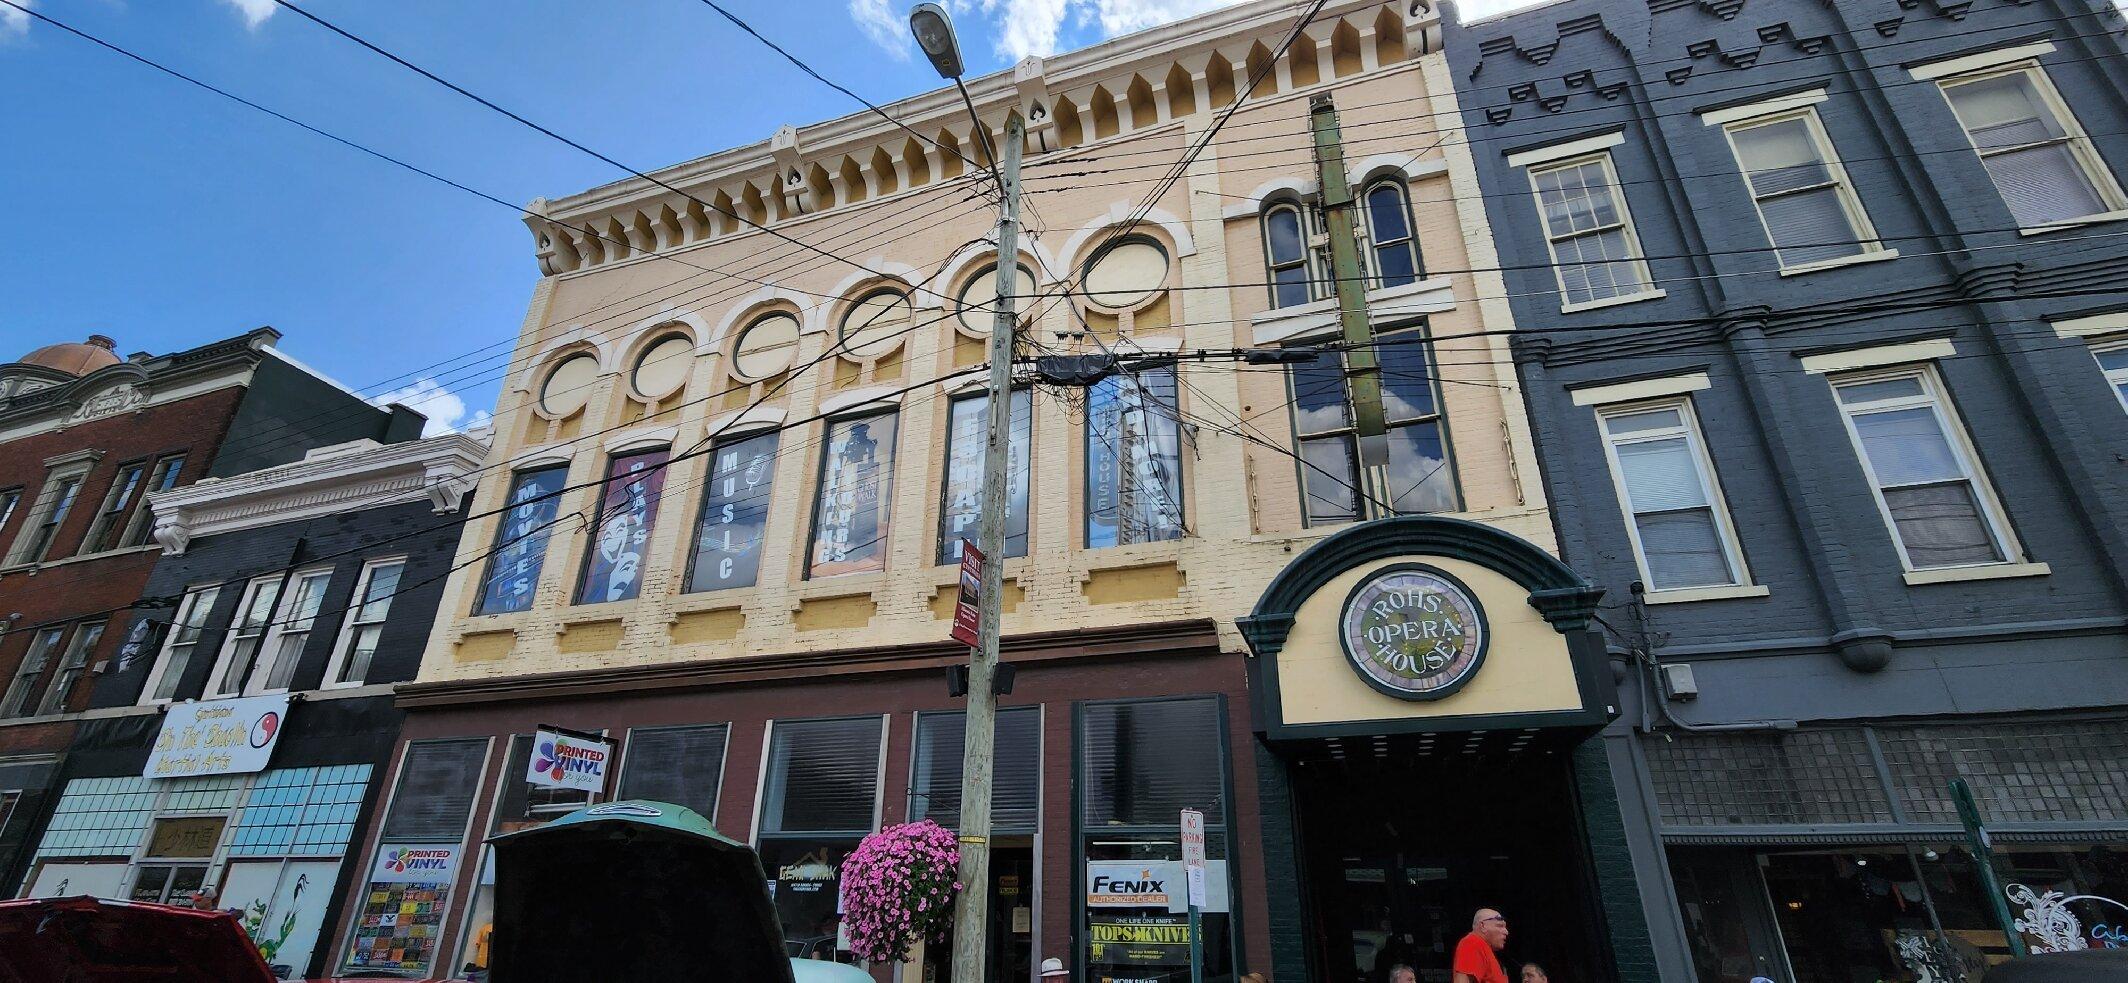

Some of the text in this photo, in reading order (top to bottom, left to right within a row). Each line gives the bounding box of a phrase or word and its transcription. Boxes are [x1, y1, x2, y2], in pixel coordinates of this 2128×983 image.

[631, 461, 647, 545] PLAYS
[720, 452, 738, 579] MUSIC
[513, 483, 537, 597] MOVIES
[965, 549, 980, 572] VISIT
[1372, 590, 1442, 619] ROHS
[1368, 618, 1461, 644] OPERA
[1376, 640, 1456, 674] HOUSE
[555, 744, 604, 762] PRINTED
[554, 756, 602, 776] VINYL
[1188, 818, 1197, 829] NO
[1183, 831, 1203, 844] PARKING
[406, 858, 446, 869] VINYL
[407, 850, 450, 858] PRINTED
[1092, 876, 1165, 893] FENIX
[1093, 895, 1166, 903] AUTHORIZED DEALER
[1092, 926, 1135, 941] TOPS
